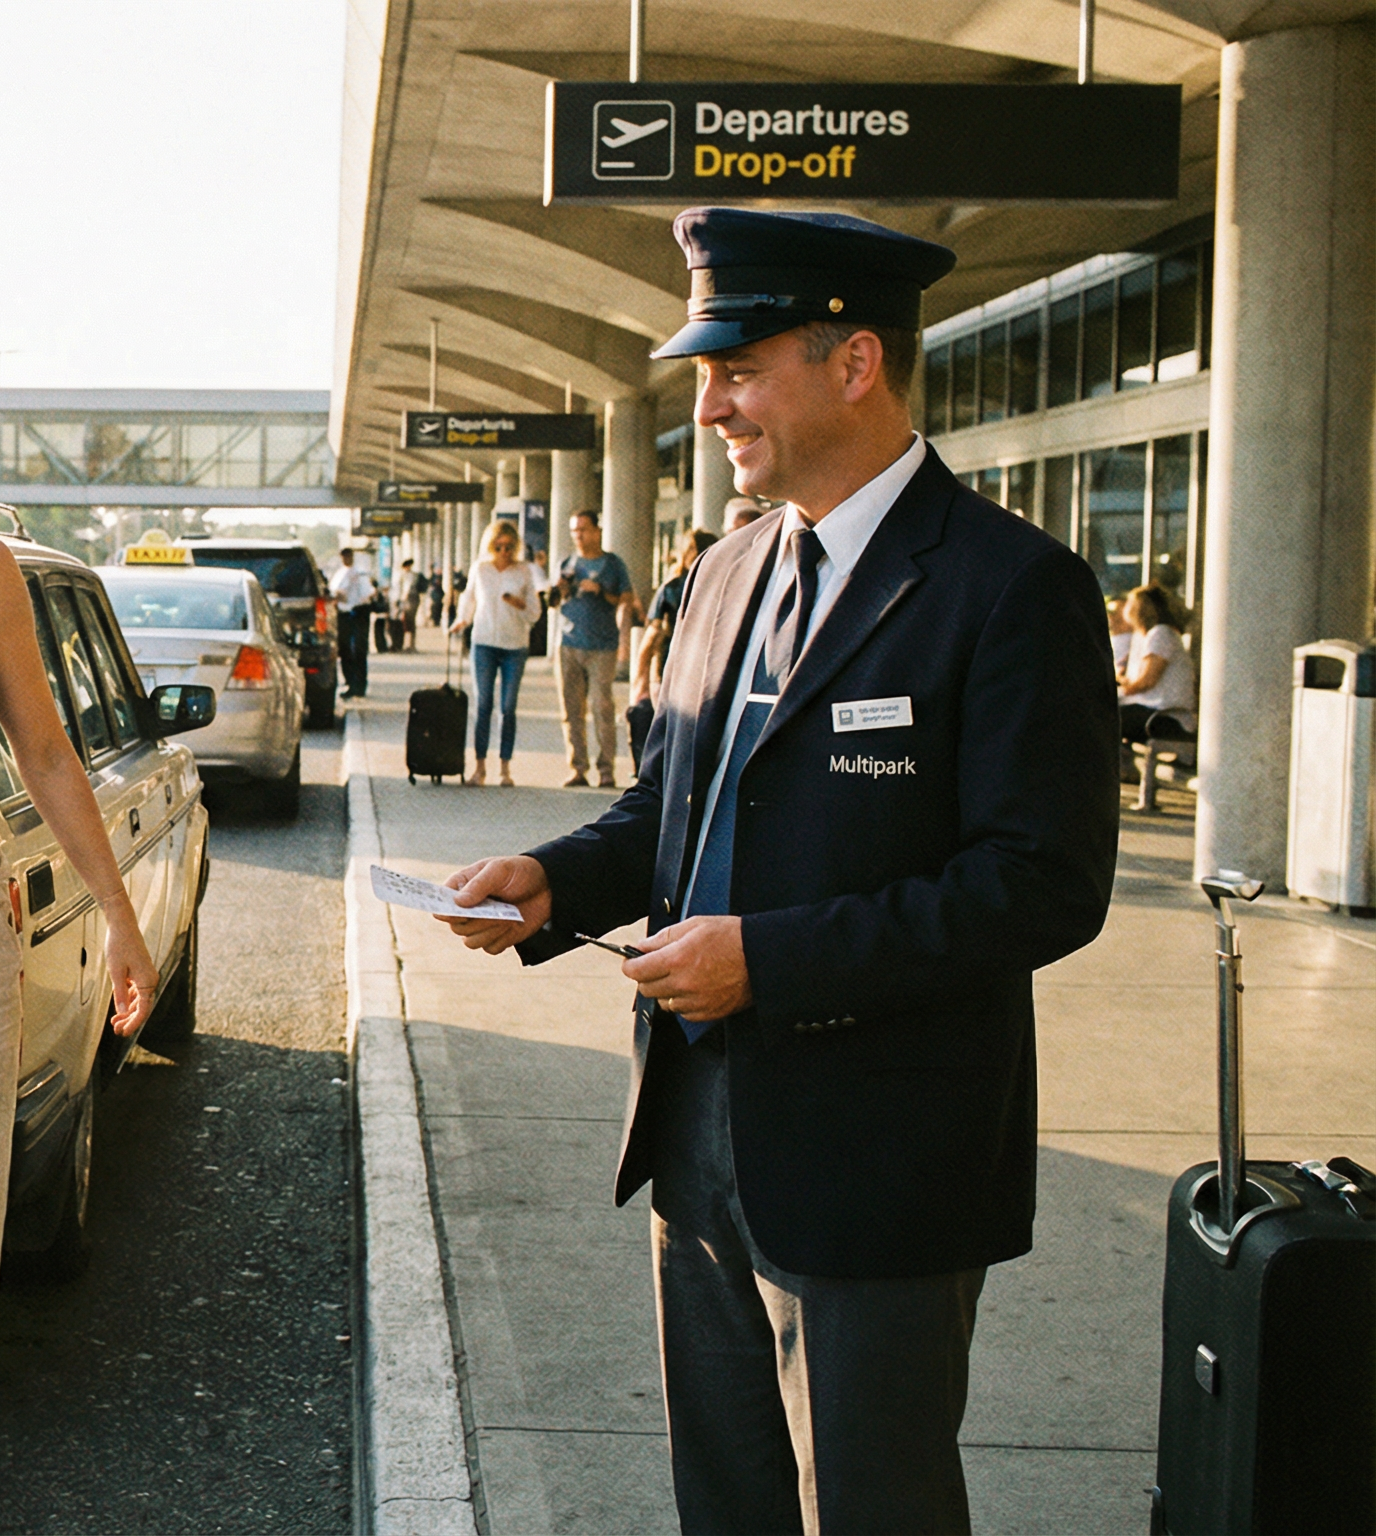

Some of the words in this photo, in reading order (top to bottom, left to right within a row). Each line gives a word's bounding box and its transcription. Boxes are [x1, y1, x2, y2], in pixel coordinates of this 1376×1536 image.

[695, 101, 910, 142] Departures
[694, 144, 856, 185] Drop-off
[133, 549, 168, 559] TAXI
[829, 754, 917, 779] Multipark
